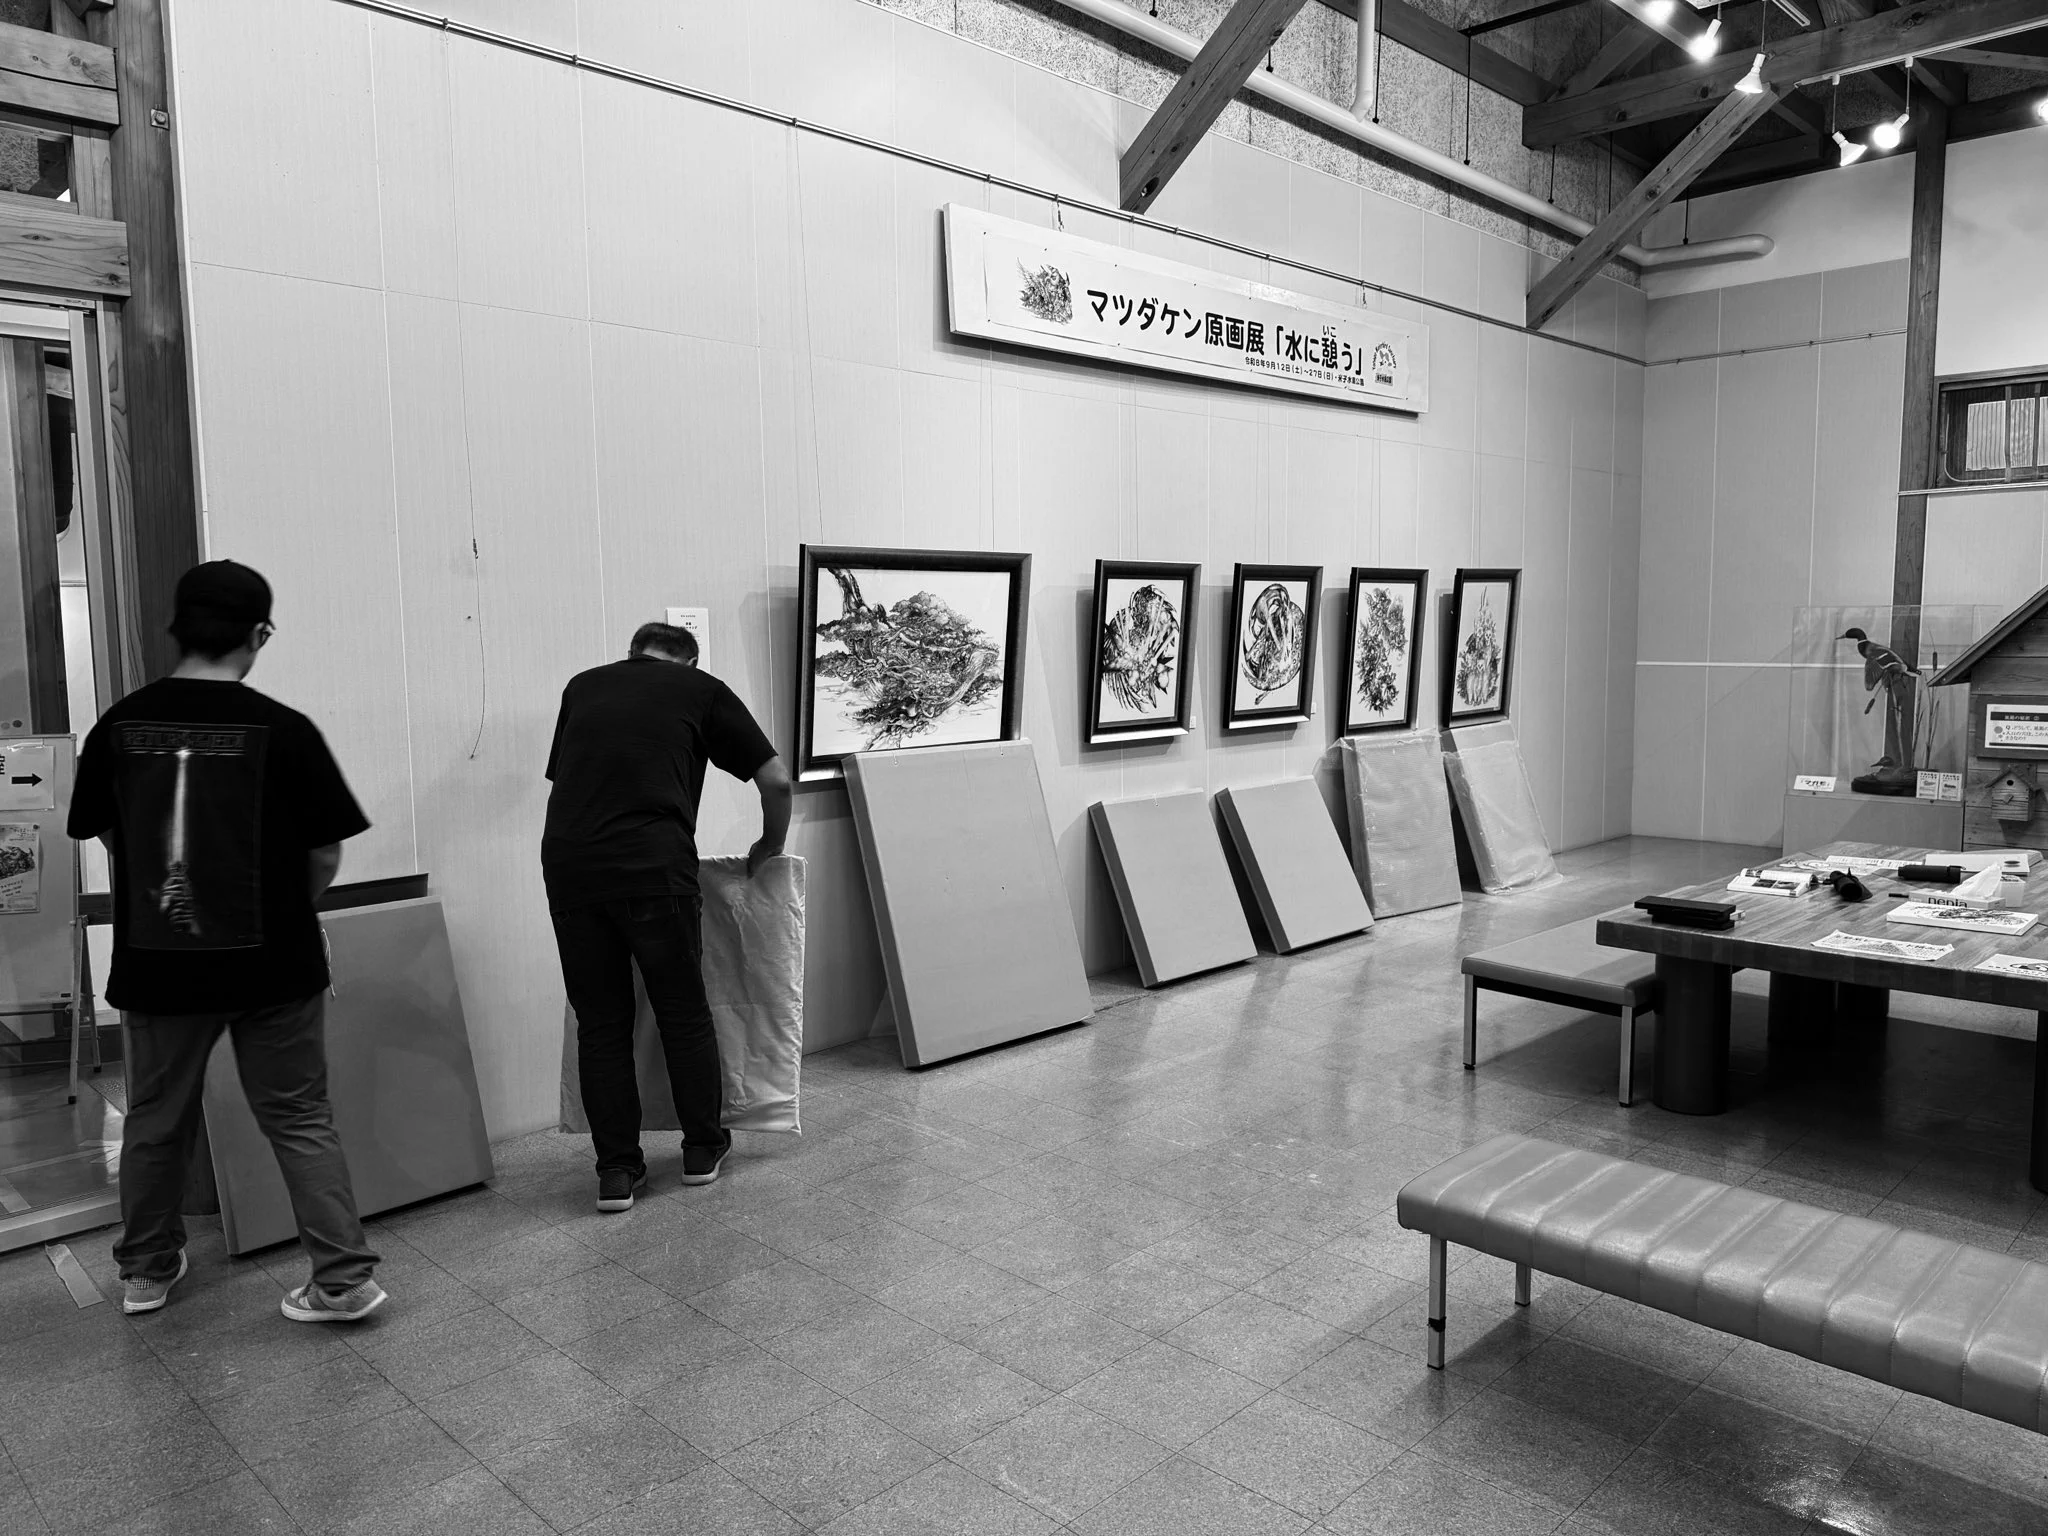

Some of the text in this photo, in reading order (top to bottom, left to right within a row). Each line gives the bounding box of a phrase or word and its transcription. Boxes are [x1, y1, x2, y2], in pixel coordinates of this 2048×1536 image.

[1086, 289, 1362, 375] マツダケン原画展「水に憩う」
[1322, 325, 1337, 337] いこ
[1928, 896, 1968, 908] nepia
